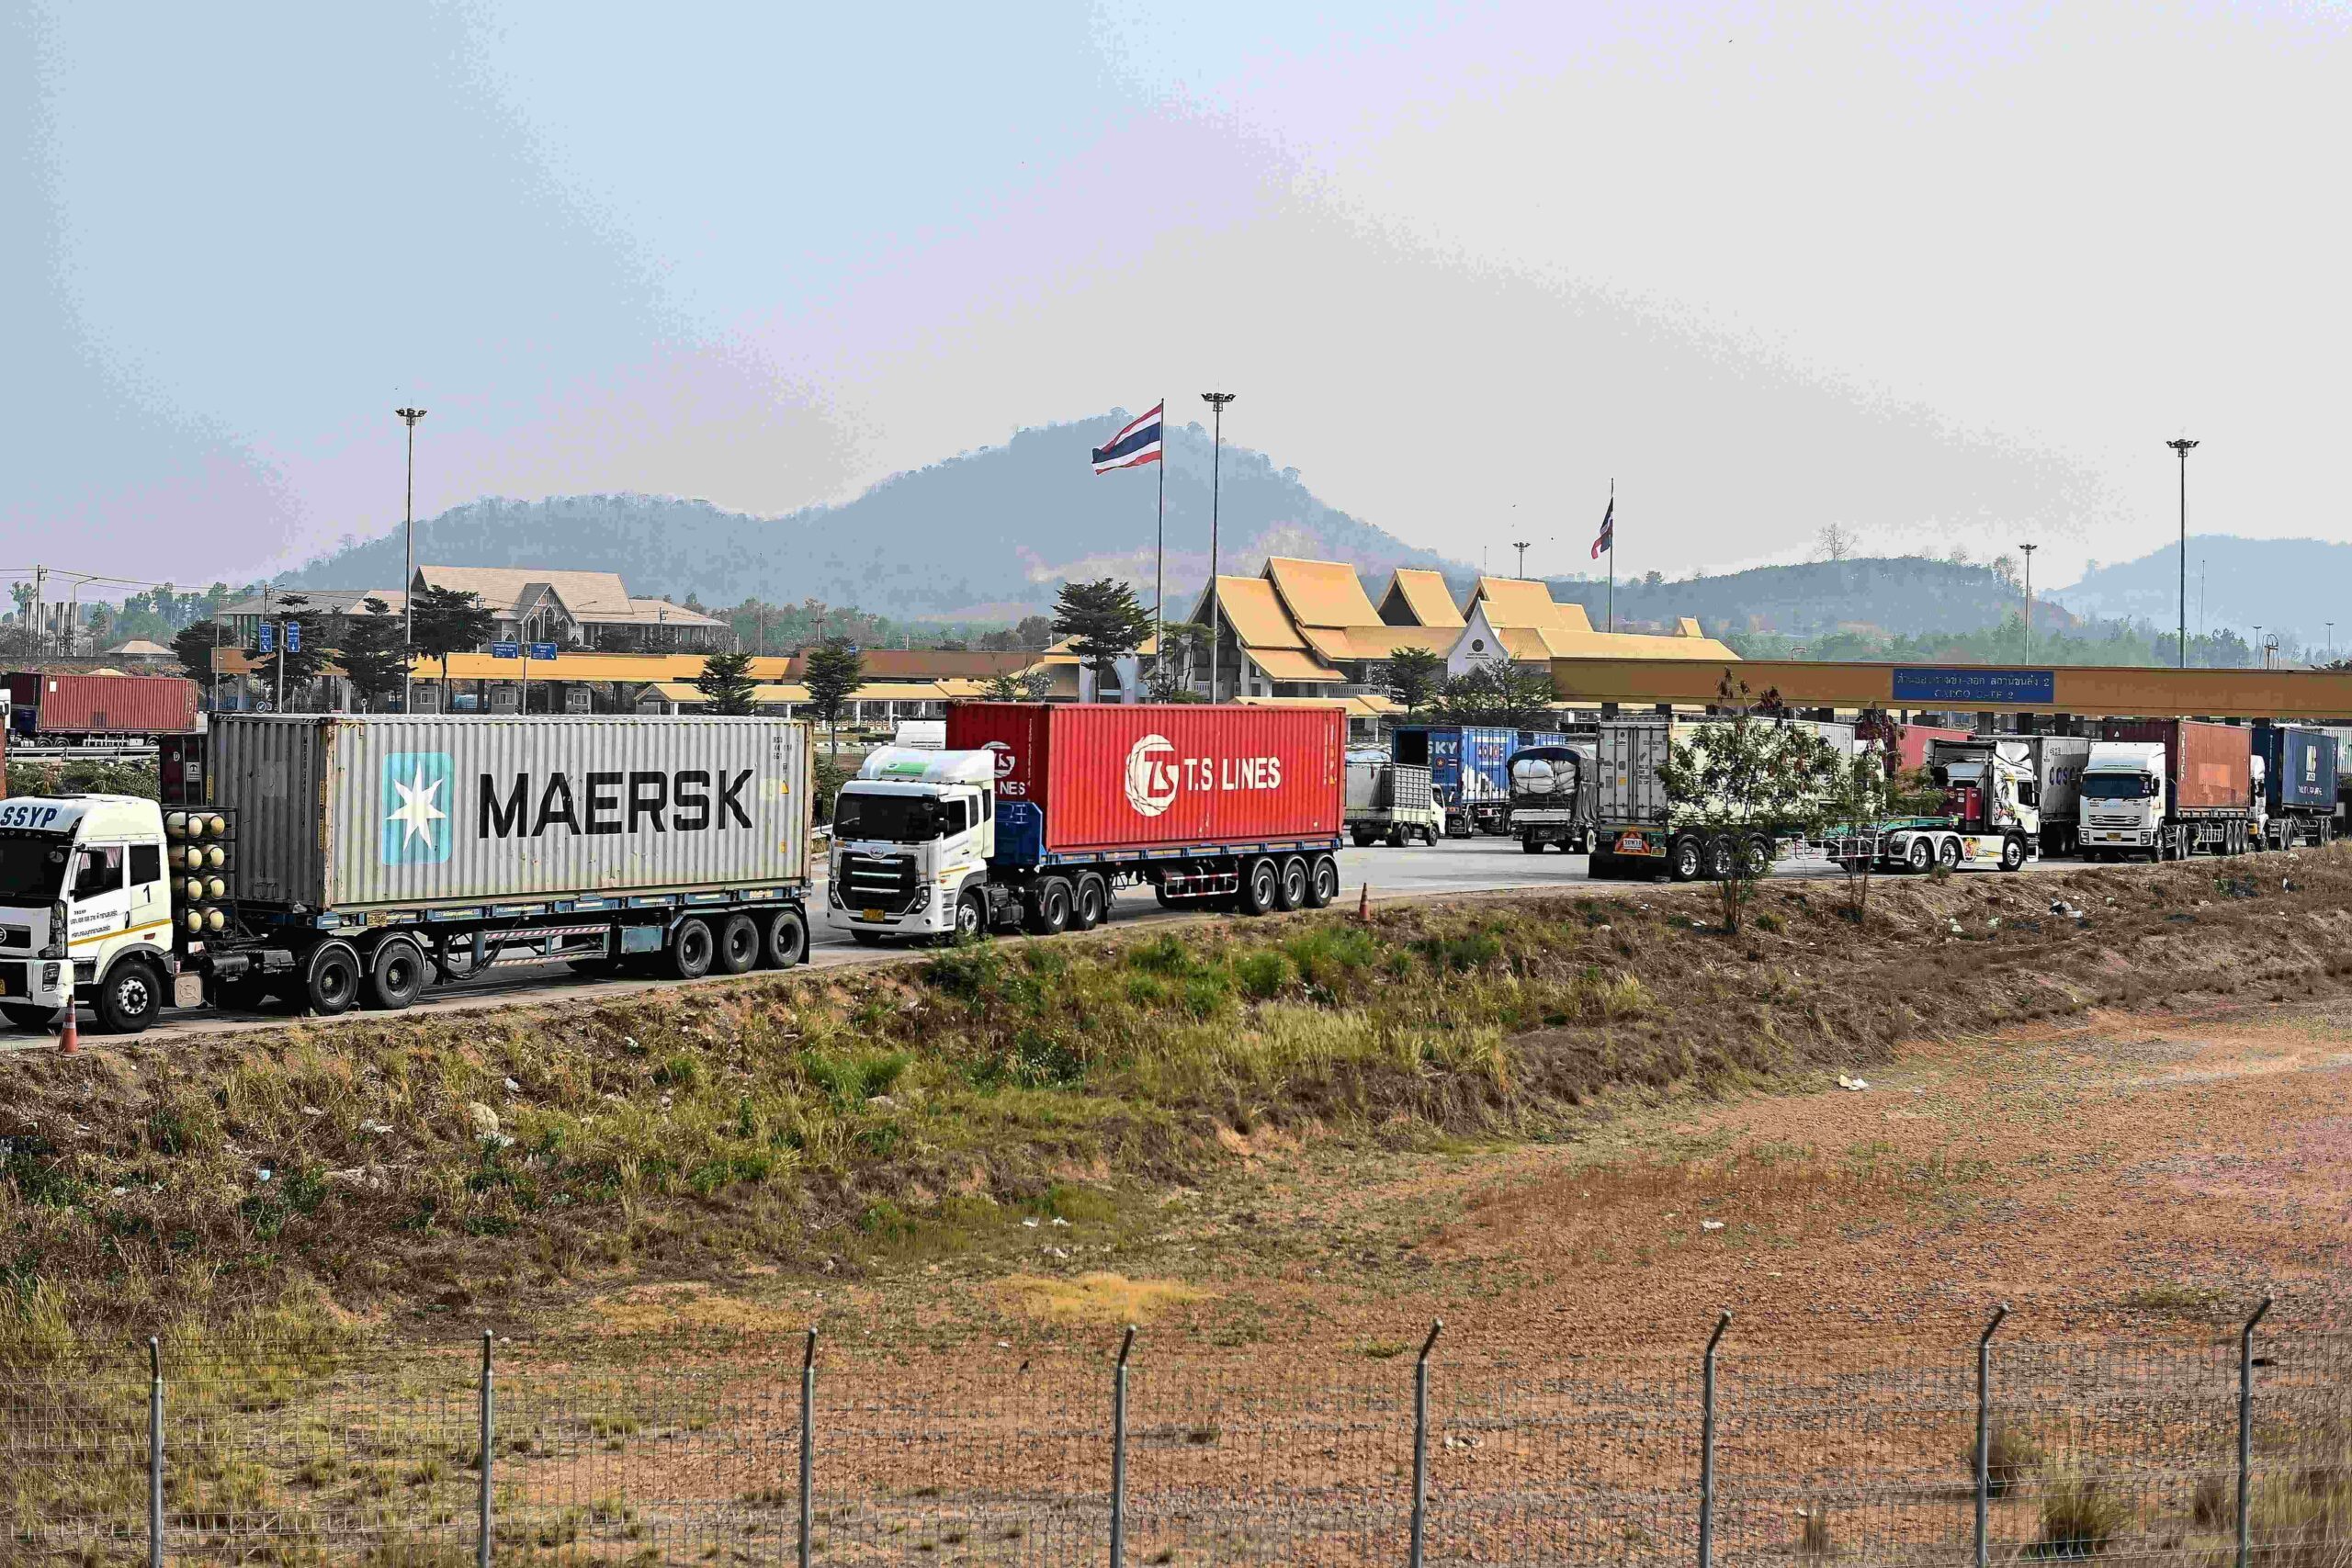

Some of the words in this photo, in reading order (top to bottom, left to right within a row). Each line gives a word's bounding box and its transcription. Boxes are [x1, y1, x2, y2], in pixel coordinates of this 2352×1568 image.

[2043, 678, 2050, 687] 2
[1222, 756, 1281, 791] LINES
[479, 769, 753, 838] MAERSK
[1, 806, 58, 829] SSYP
[142, 885, 151, 903] 1
